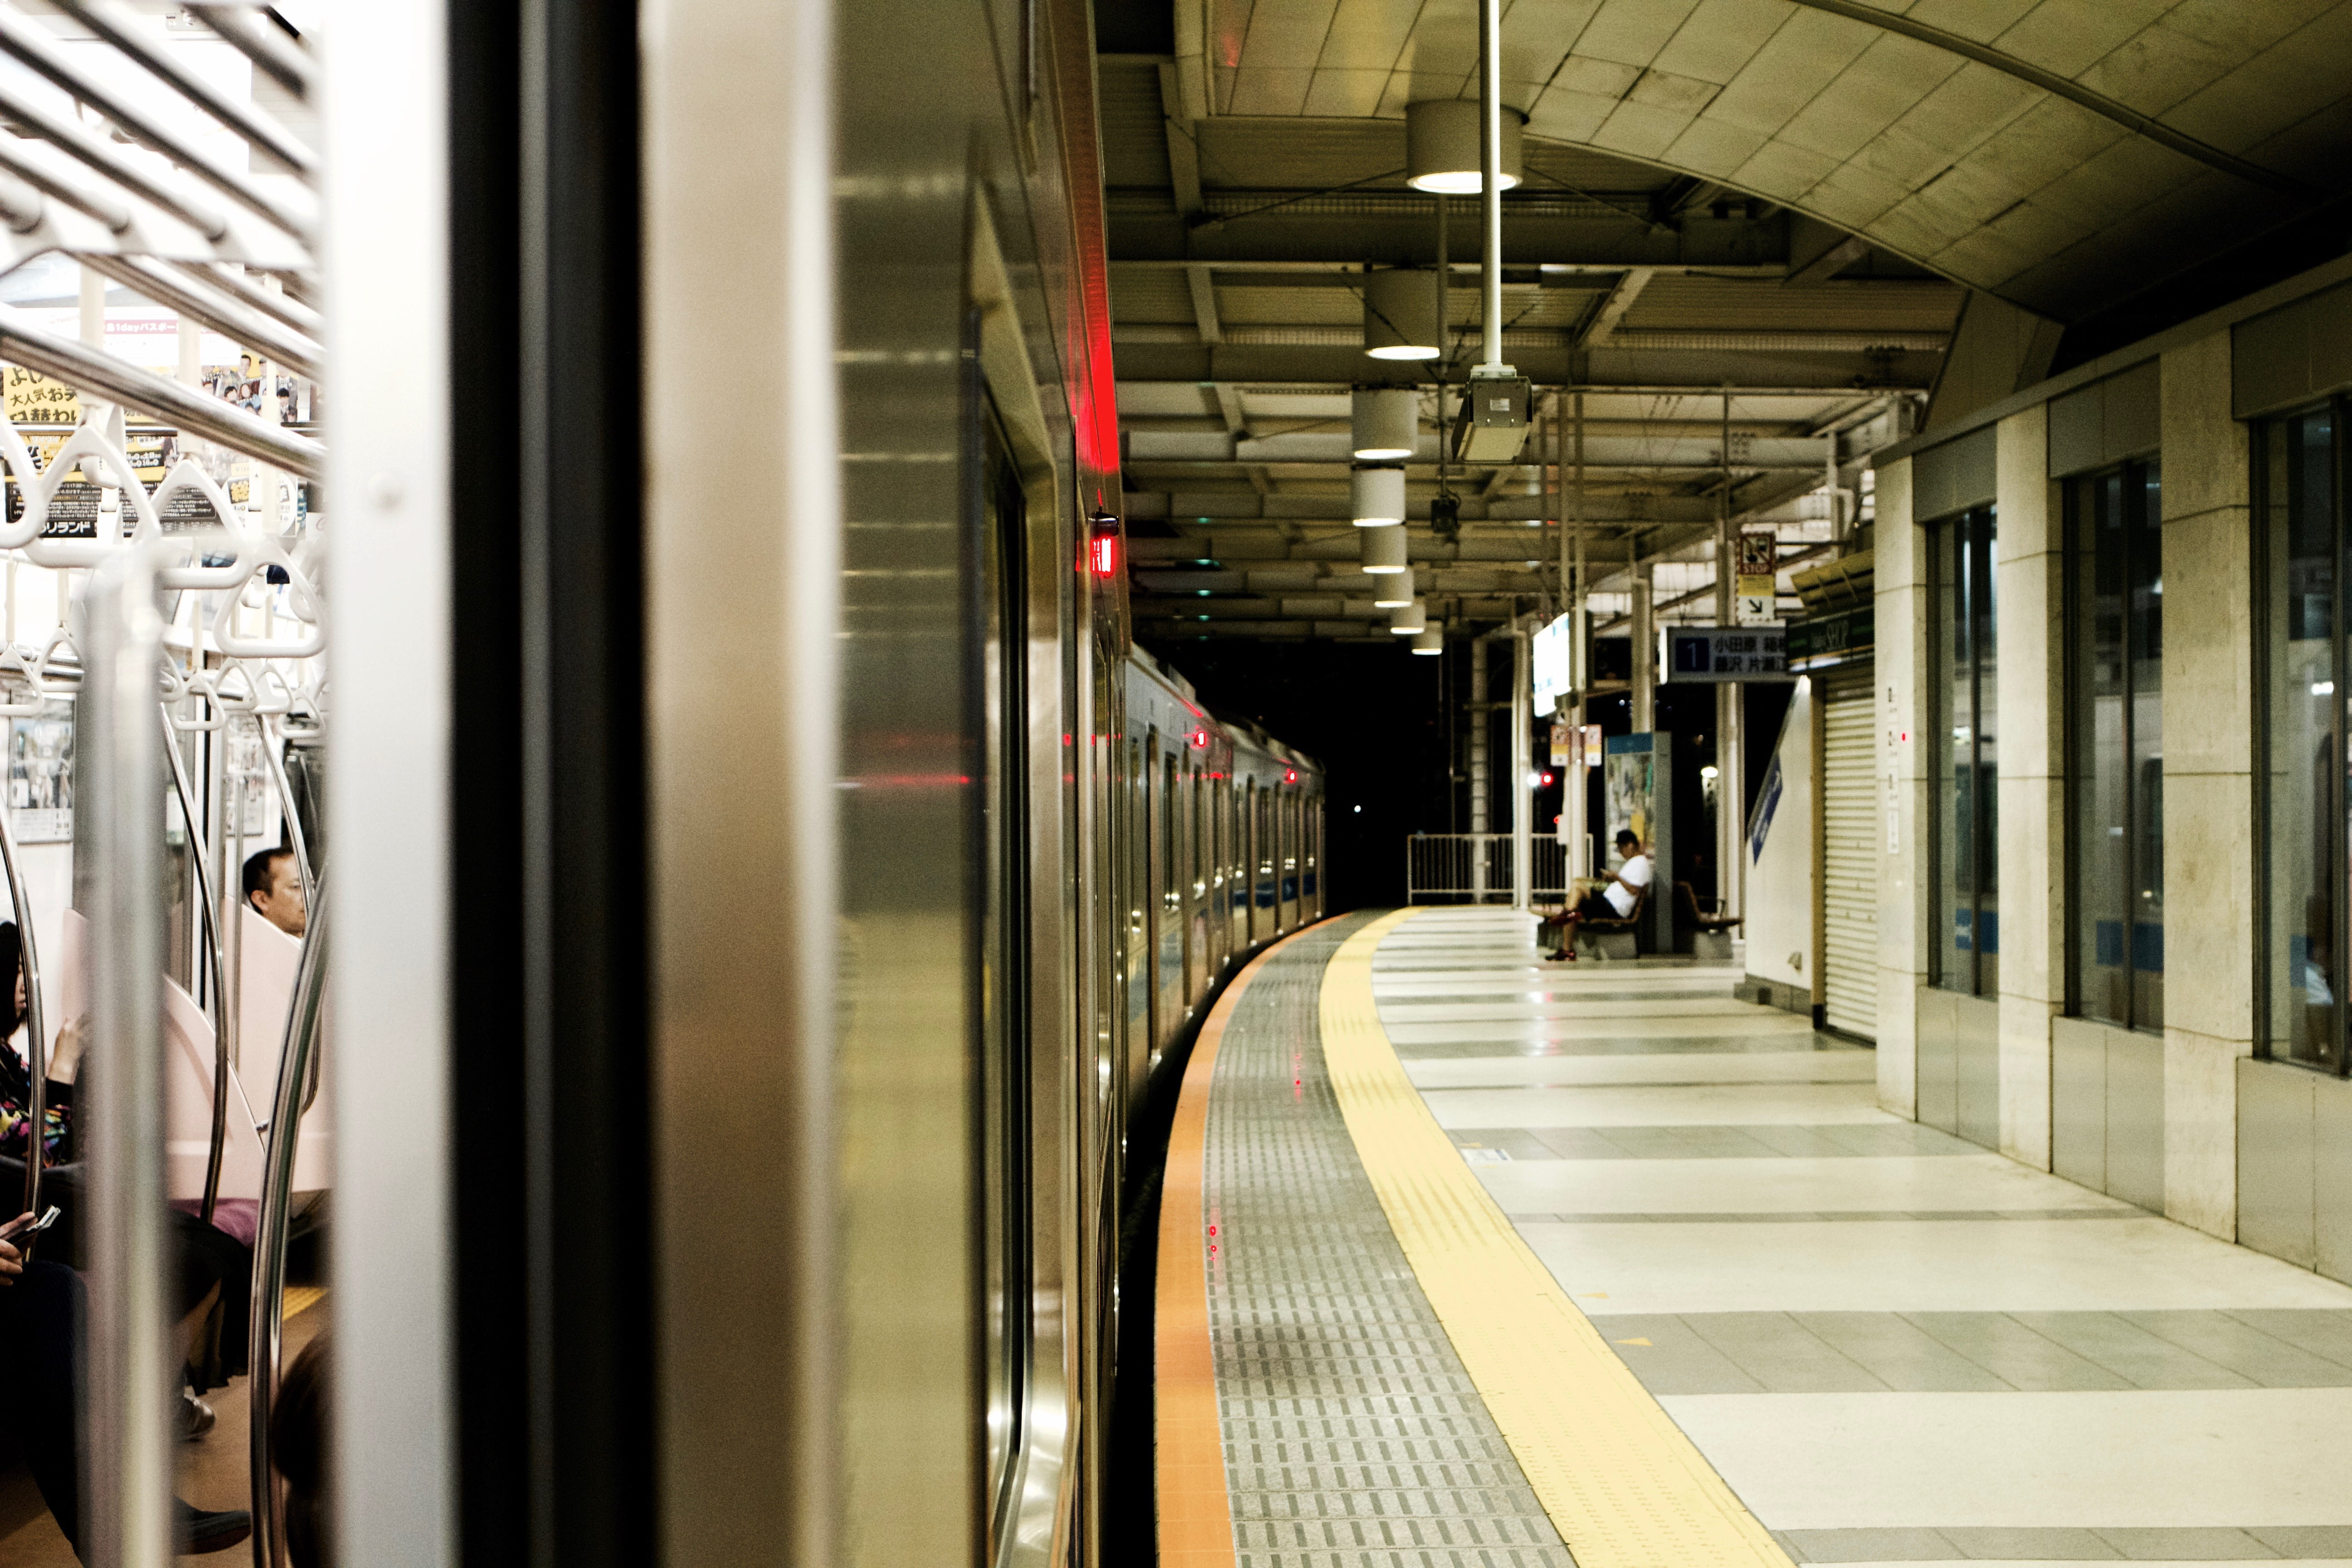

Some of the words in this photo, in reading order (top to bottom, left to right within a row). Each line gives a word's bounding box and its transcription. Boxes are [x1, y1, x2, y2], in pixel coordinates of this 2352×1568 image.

[104, 323, 178, 333] 島1dayパスポー
[1686, 642, 1697, 668] 1
